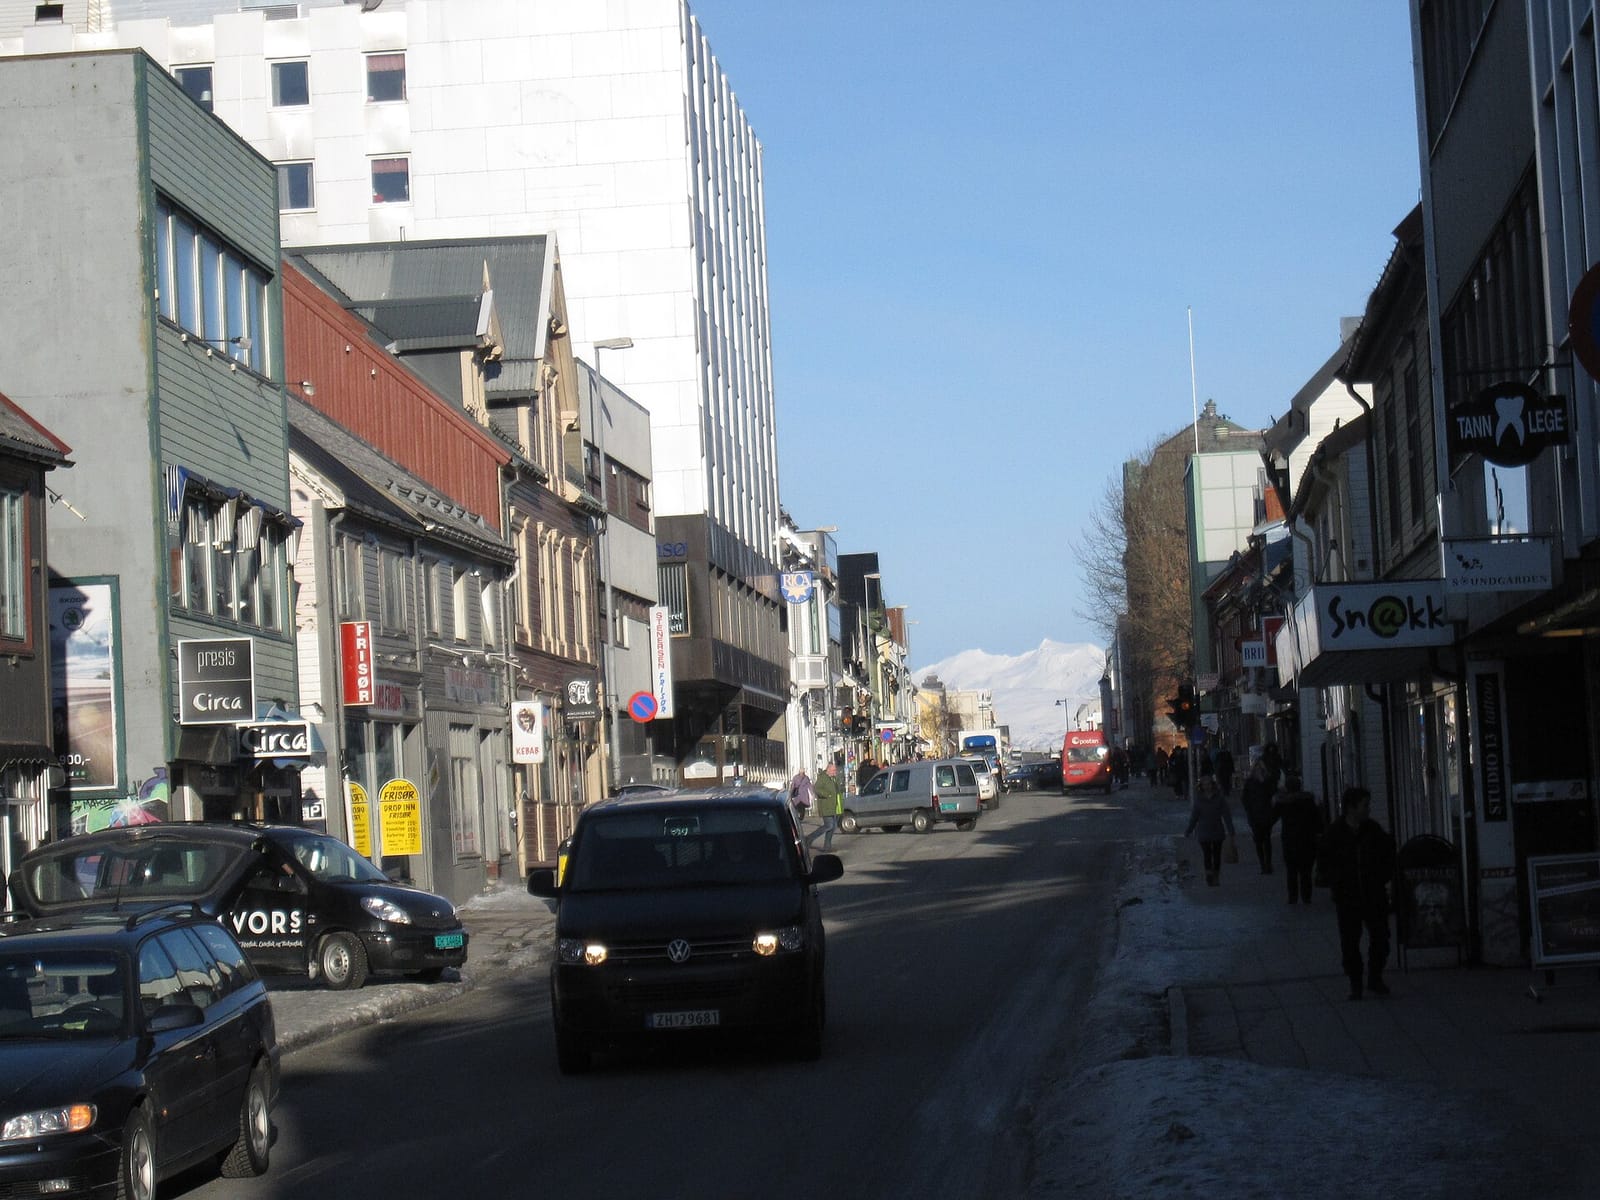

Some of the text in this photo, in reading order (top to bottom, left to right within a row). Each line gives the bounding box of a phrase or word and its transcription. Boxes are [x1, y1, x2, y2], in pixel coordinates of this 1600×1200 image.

[1457, 409, 1564, 439] TANN LEGE
[781, 573, 811, 588] RICA
[1327, 595, 1445, 639] Sn@kk
[197, 648, 235, 673] presis
[356, 624, 370, 702] FRISØR
[193, 693, 243, 711] Circa
[242, 727, 309, 753] Circa
[516, 746, 540, 756] KEBAB
[384, 791, 415, 800] FRISØR
[1487, 753, 1503, 817] STUDIO
[217, 911, 301, 933] VORS
[656, 1011, 718, 1027] ZH 29681
